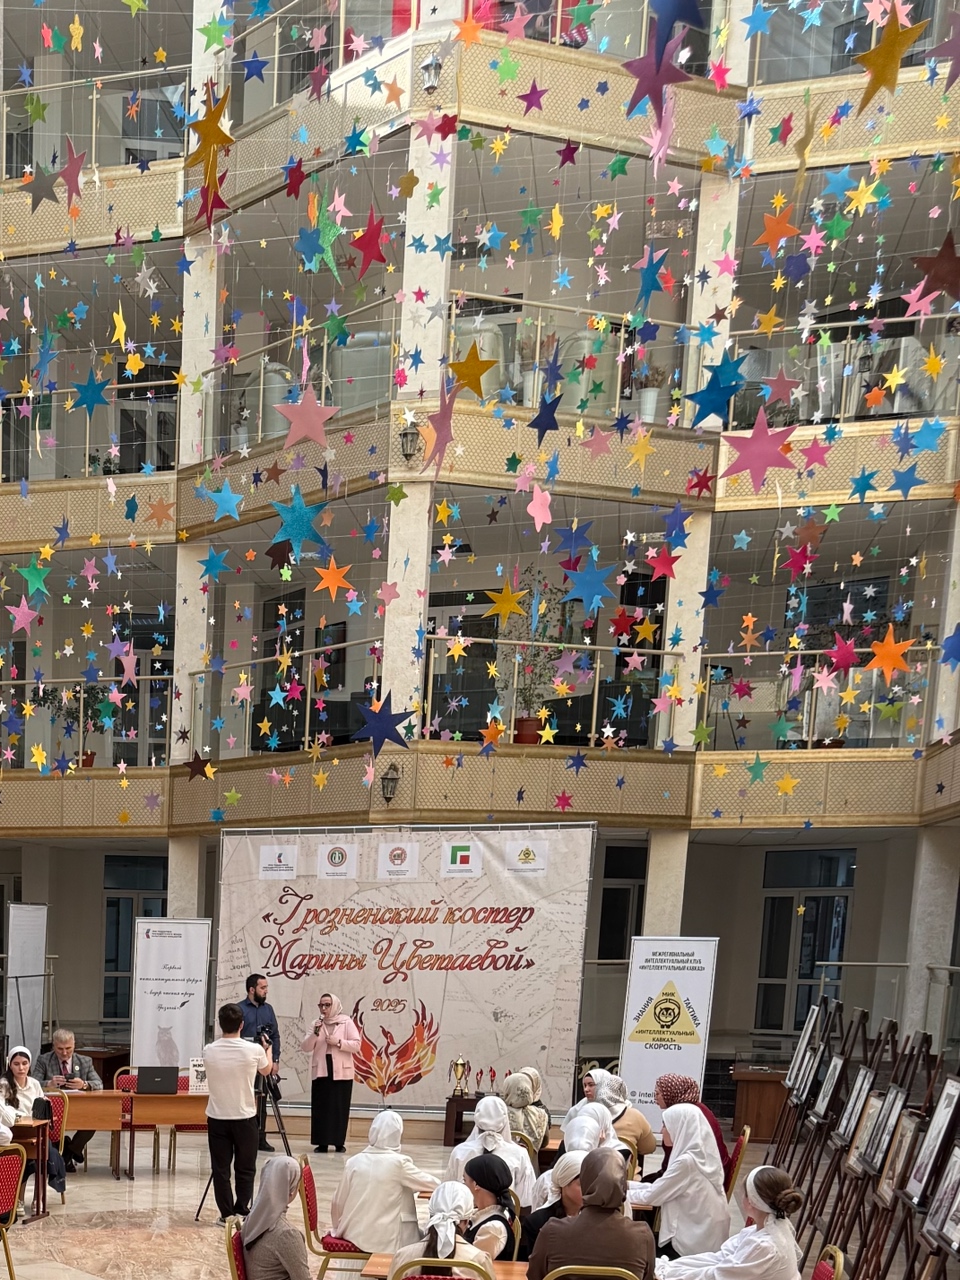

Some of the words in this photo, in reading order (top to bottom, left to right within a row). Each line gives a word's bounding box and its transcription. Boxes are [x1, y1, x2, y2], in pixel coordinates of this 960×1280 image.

[261, 886, 444, 936] «Грозненский
[442, 904, 535, 934] костер
[259, 934, 368, 980] Марины
[372, 937, 536, 984] Цветаевой»
[370, 998, 408, 1014] 2025
[632, 996, 654, 1023] ЗНАНИЯ
[683, 997, 701, 1028] ТАКТИКА
[644, 1043, 682, 1051] СКОРОСТЬ
